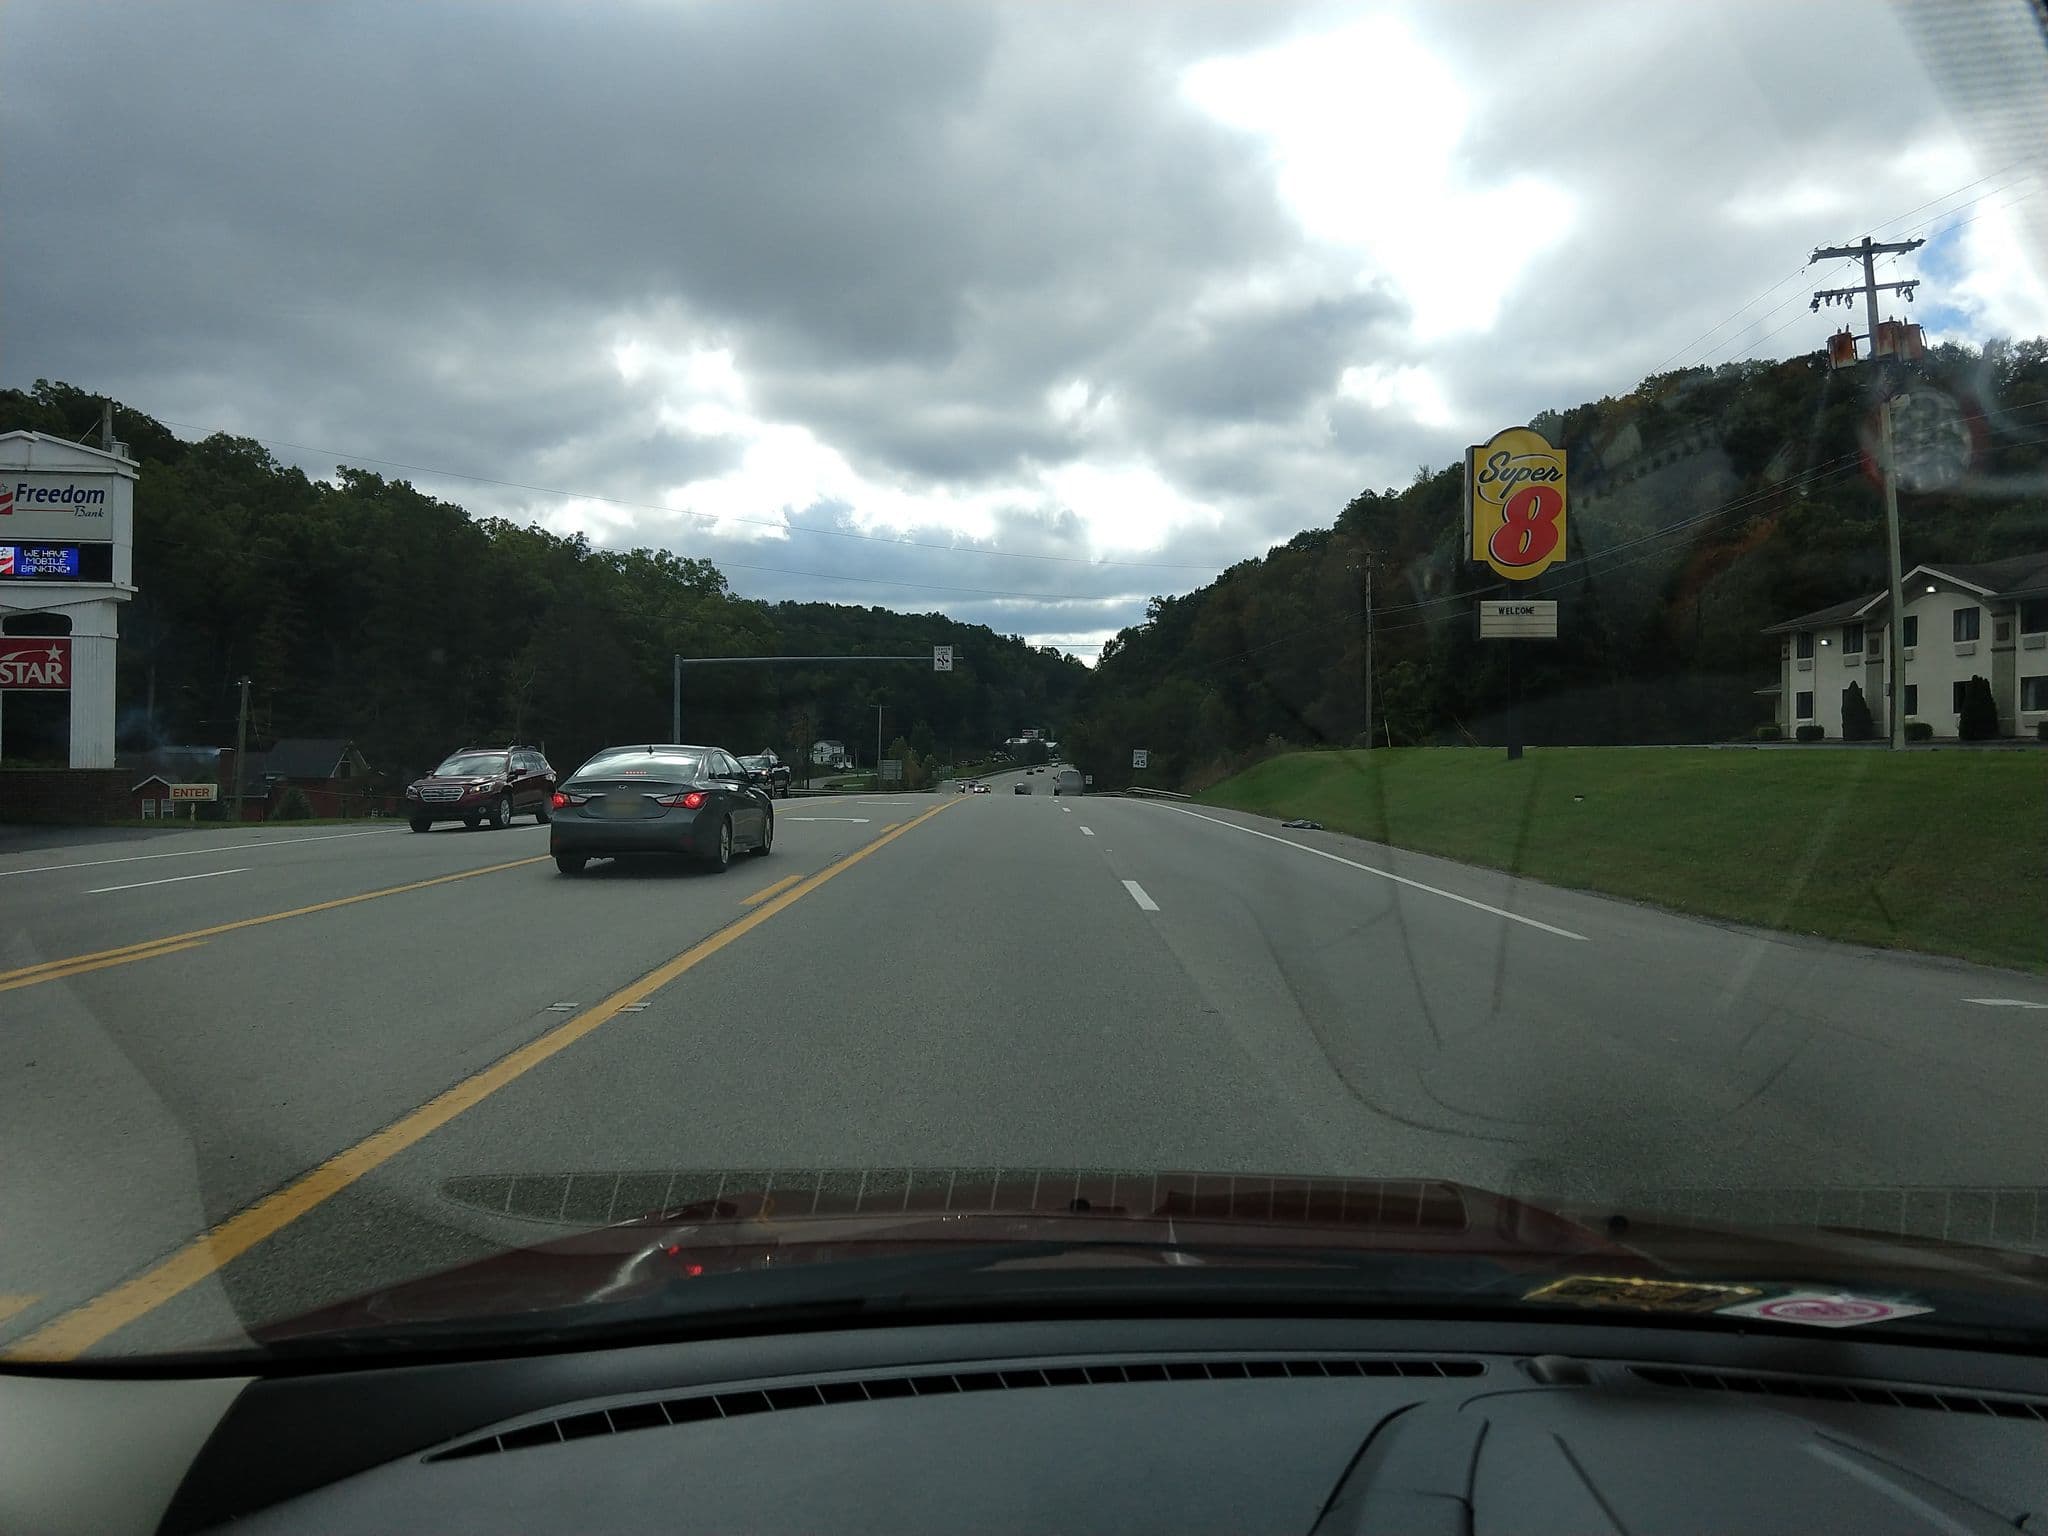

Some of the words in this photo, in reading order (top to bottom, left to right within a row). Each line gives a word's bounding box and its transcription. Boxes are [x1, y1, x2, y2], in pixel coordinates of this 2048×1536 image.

[1479, 451, 1563, 499] Super
[15, 483, 105, 504] Freedom
[73, 505, 104, 517] Bank
[1489, 485, 1563, 567] 8
[42, 550, 69, 558] HAVE
[25, 558, 66, 566] MOBILE
[1498, 606, 1535, 615] WELCOME
[173, 788, 209, 798] ENTER
